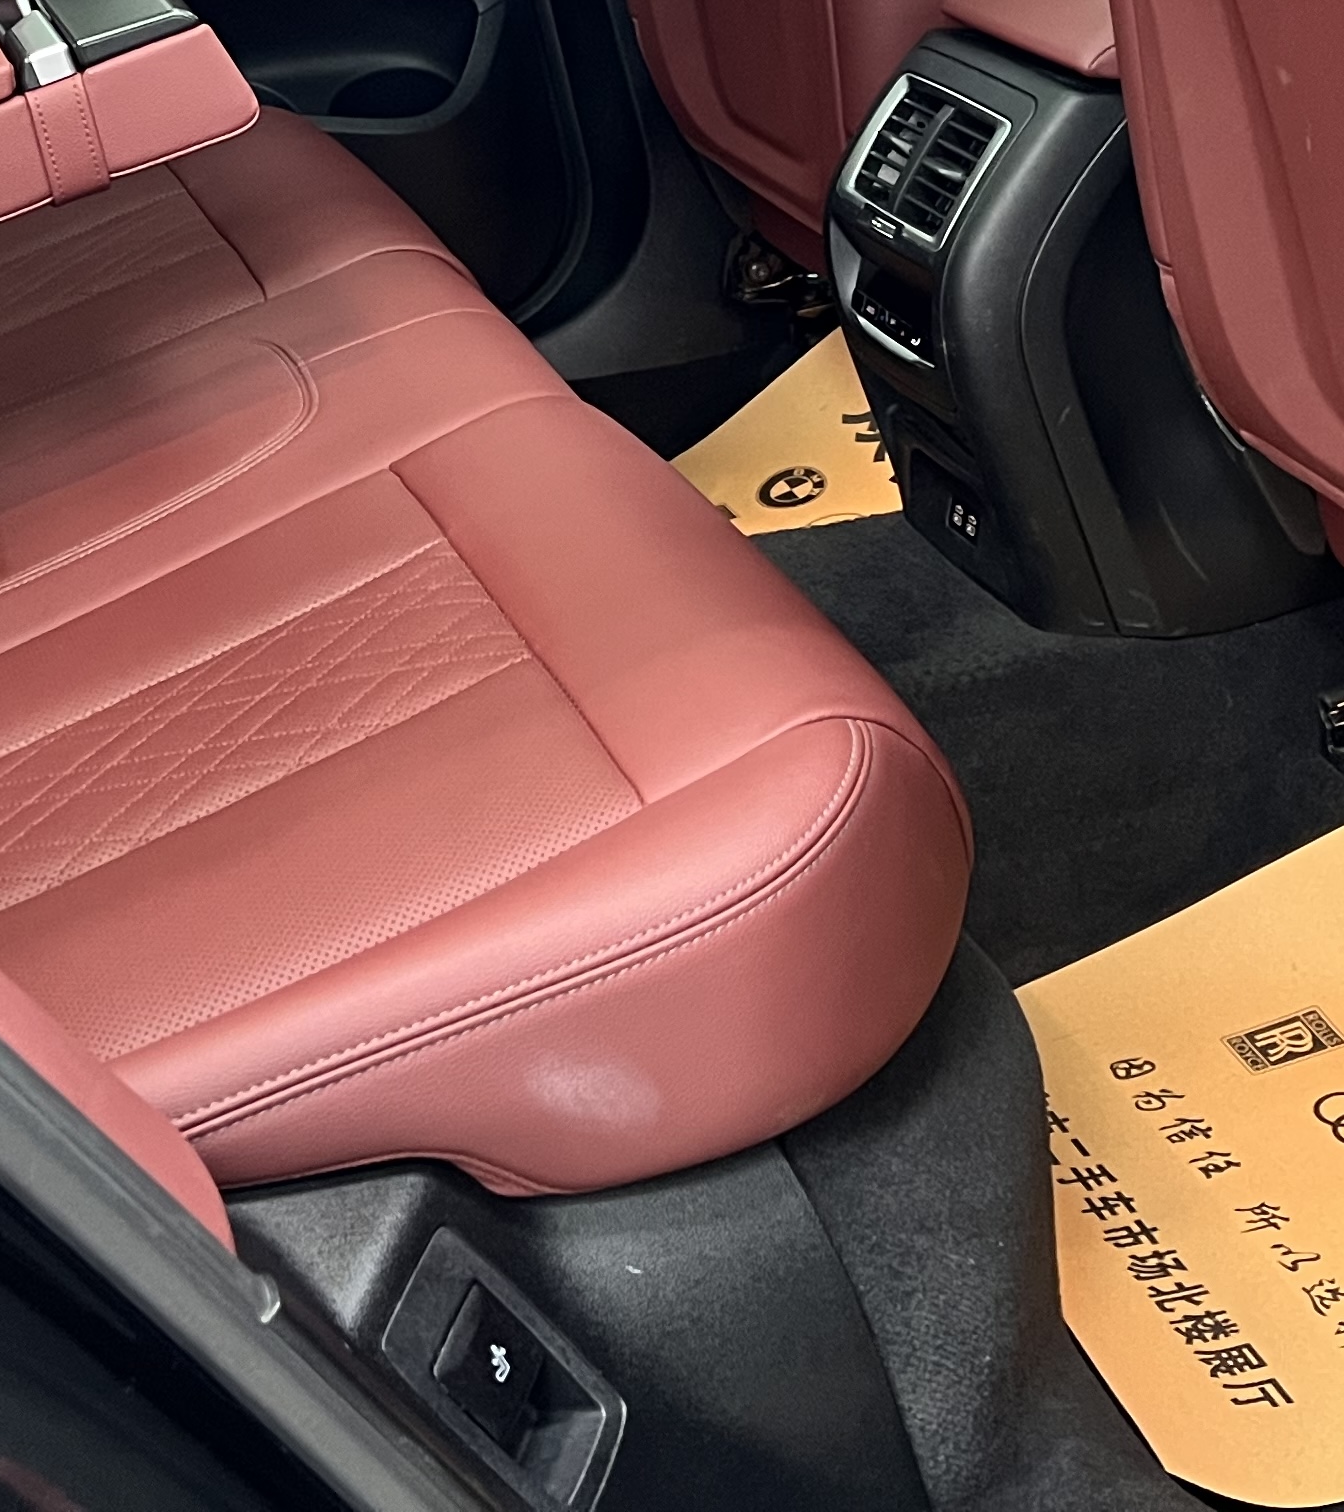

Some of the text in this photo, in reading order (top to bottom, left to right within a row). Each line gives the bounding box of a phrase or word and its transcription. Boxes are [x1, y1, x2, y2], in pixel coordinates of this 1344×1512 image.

[1306, 1013, 1343, 1046] ROLLS
[1109, 1057, 1241, 1179] 因为信任
